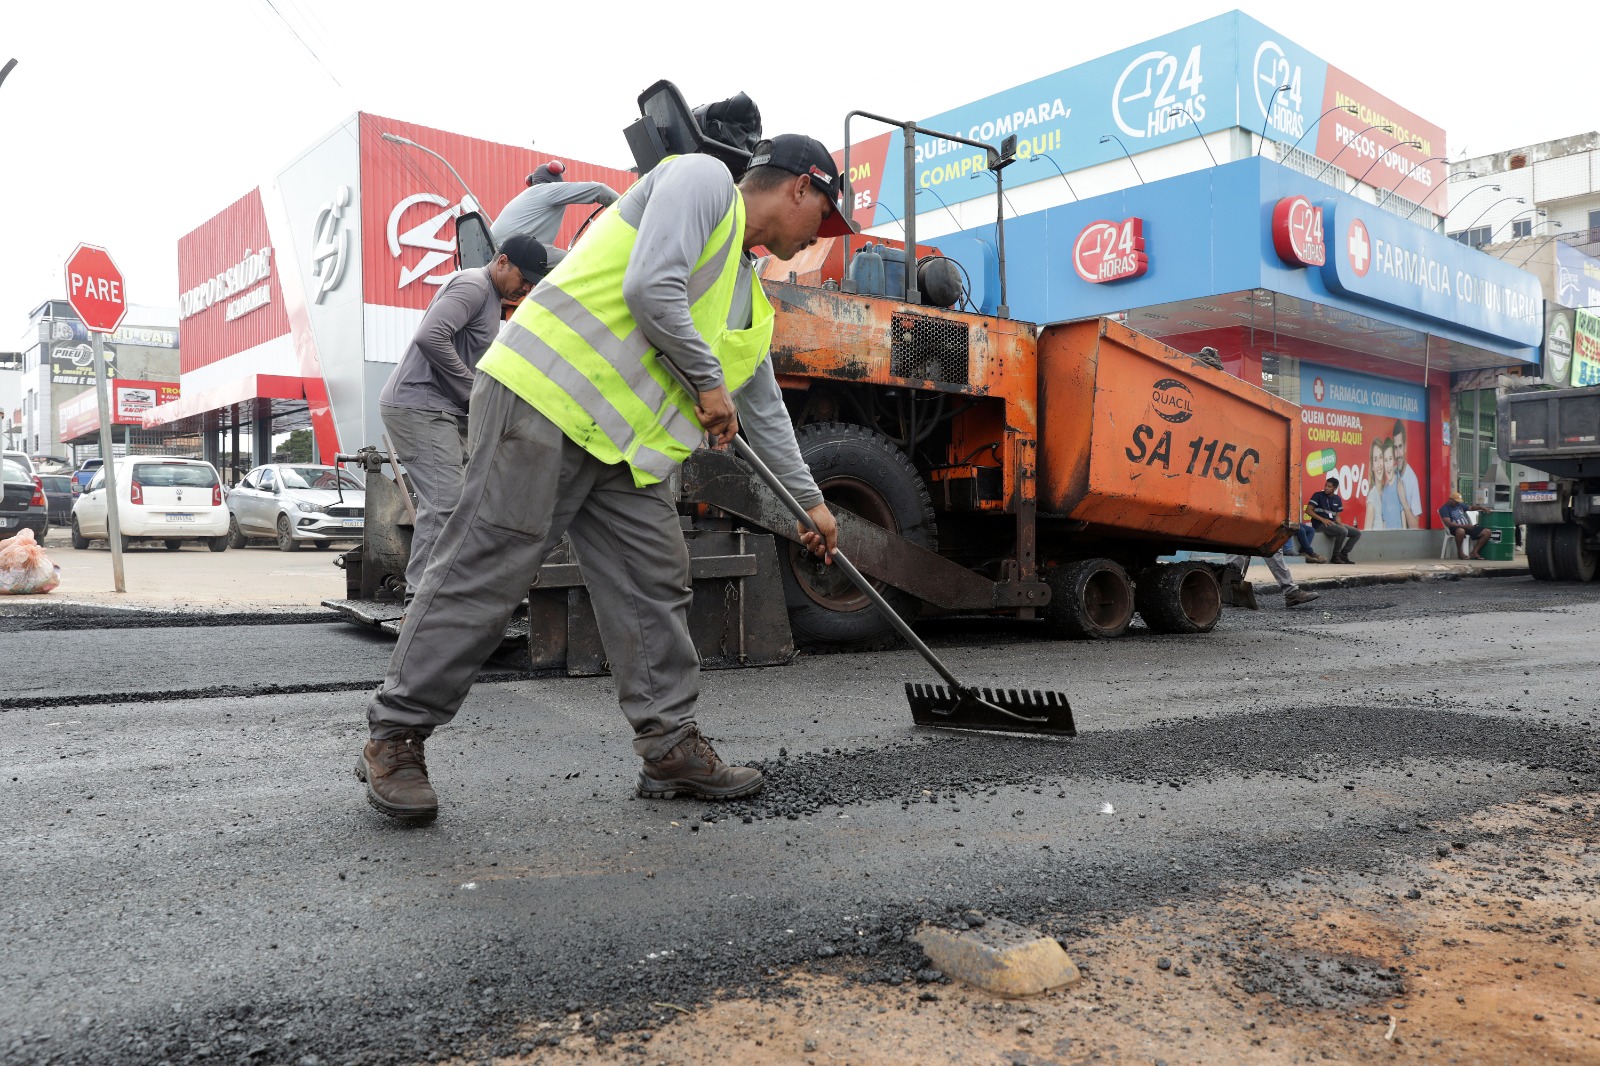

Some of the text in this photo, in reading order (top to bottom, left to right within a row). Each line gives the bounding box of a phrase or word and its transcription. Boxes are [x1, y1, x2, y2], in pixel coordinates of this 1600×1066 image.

[1154, 45, 1203, 108] 24
[1277, 58, 1302, 112] 24
[914, 98, 1072, 164] QUEM COMPARA,
[1147, 94, 1206, 138] HORAS
[1273, 104, 1304, 139] HORAS
[1335, 90, 1431, 157] MEDICAMENTOS COM
[1011, 128, 1061, 160] QUI!
[1335, 122, 1432, 187] PREÇOS POPULARES
[1103, 221, 1133, 261] 24
[1305, 208, 1322, 244] 24
[1099, 253, 1136, 279] HORAS
[1302, 243, 1323, 262] HORAS
[71, 272, 122, 304] PARE
[179, 278, 216, 321] CORPO
[225, 246, 272, 297] SAÚDE
[1375, 238, 1451, 296] FARMÁCIA
[1455, 270, 1538, 326] COMUNITÁRIA
[225, 284, 271, 322] ACADEMIA
[54, 349, 82, 359] PNEU
[140, 330, 173, 344] CAR
[53, 375, 78, 384] NOVOS
[1152, 390, 1193, 412] QUACIL
[1329, 384, 1419, 413] FARMÁCIA COMUNITÁRIA
[1301, 409, 1363, 431] QUEM COMPARA,
[1308, 427, 1363, 446] COMPRA AQUI!
[1125, 424, 1260, 485] SA 115C
[1308, 454, 1336, 470] DESCONTOS
